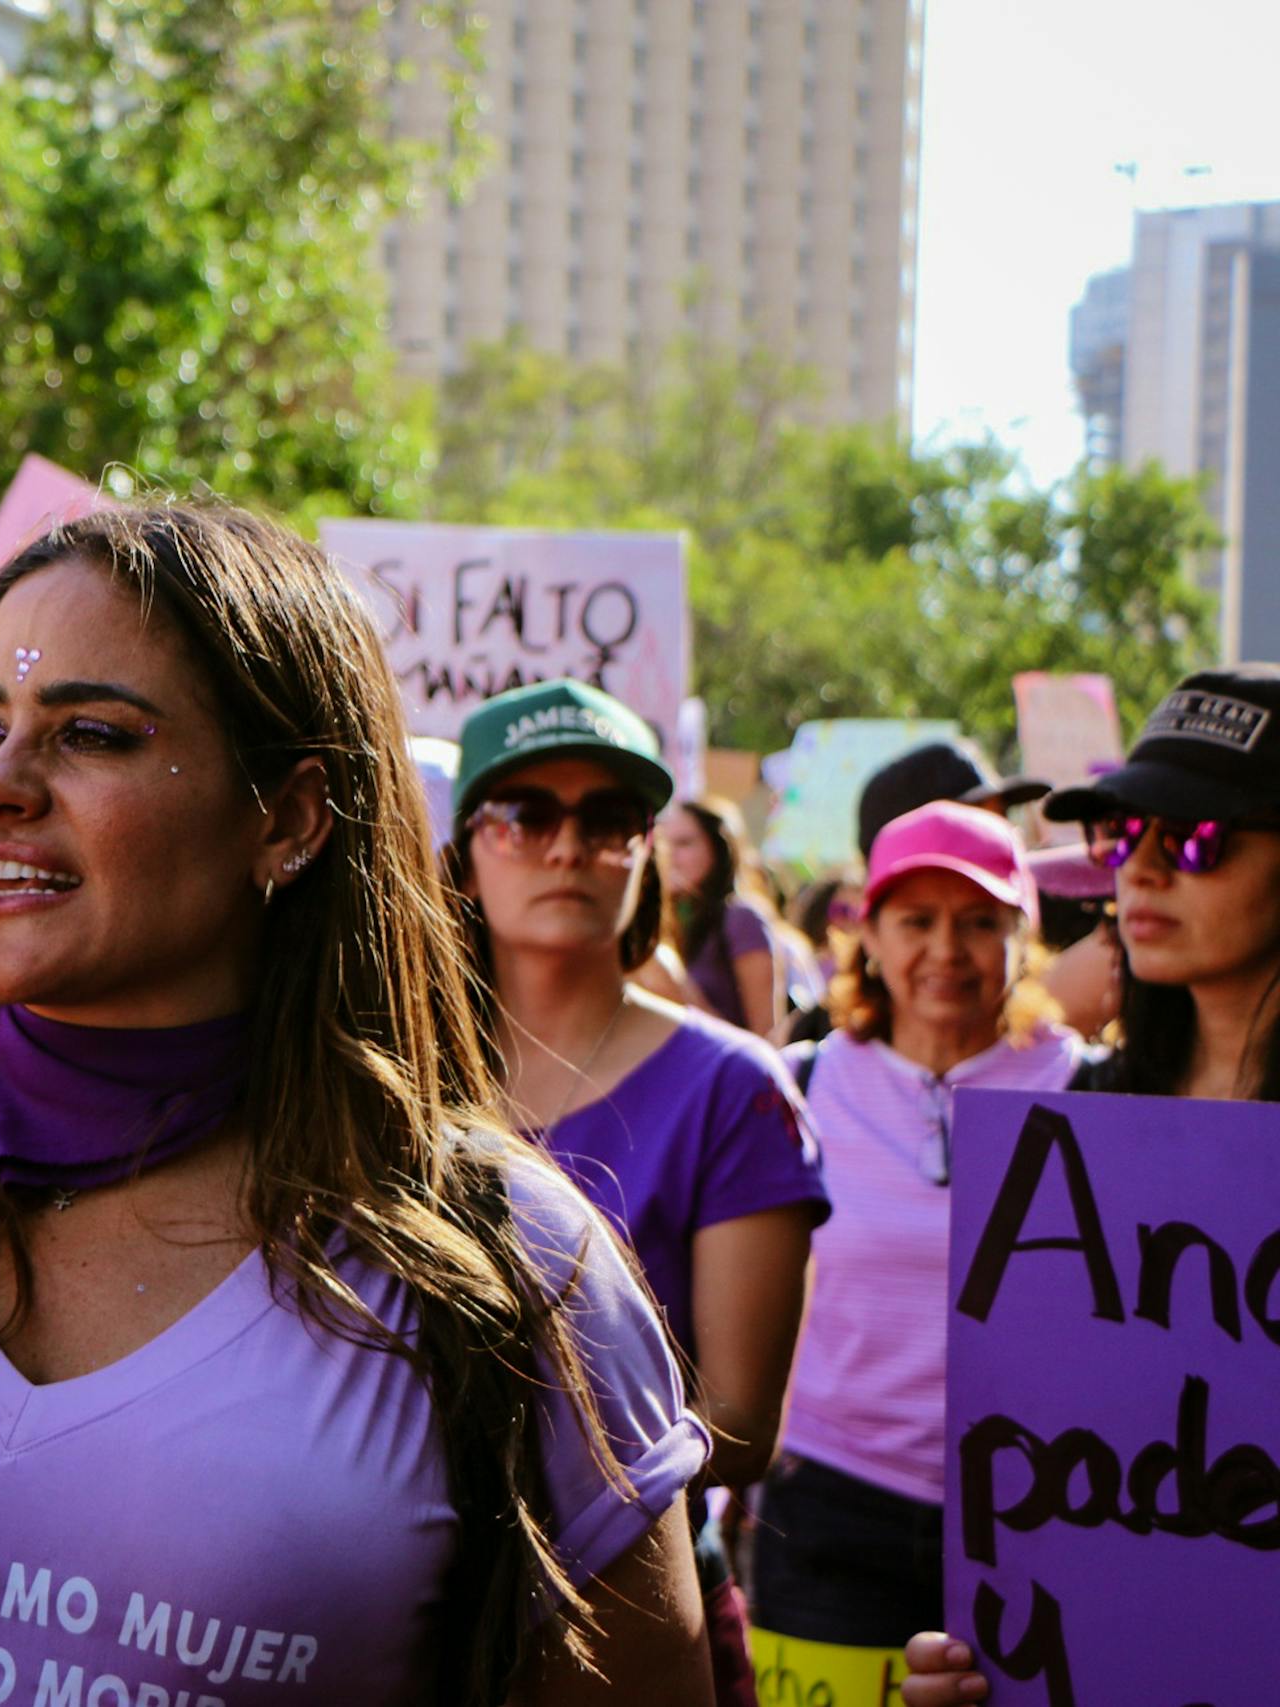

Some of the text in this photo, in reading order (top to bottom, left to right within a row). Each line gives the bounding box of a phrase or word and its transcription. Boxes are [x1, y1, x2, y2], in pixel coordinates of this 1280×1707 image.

[453, 557, 638, 656] FALTO
[503, 705, 628, 749] JAMESON
[118, 1592, 318, 1684] MUJER
